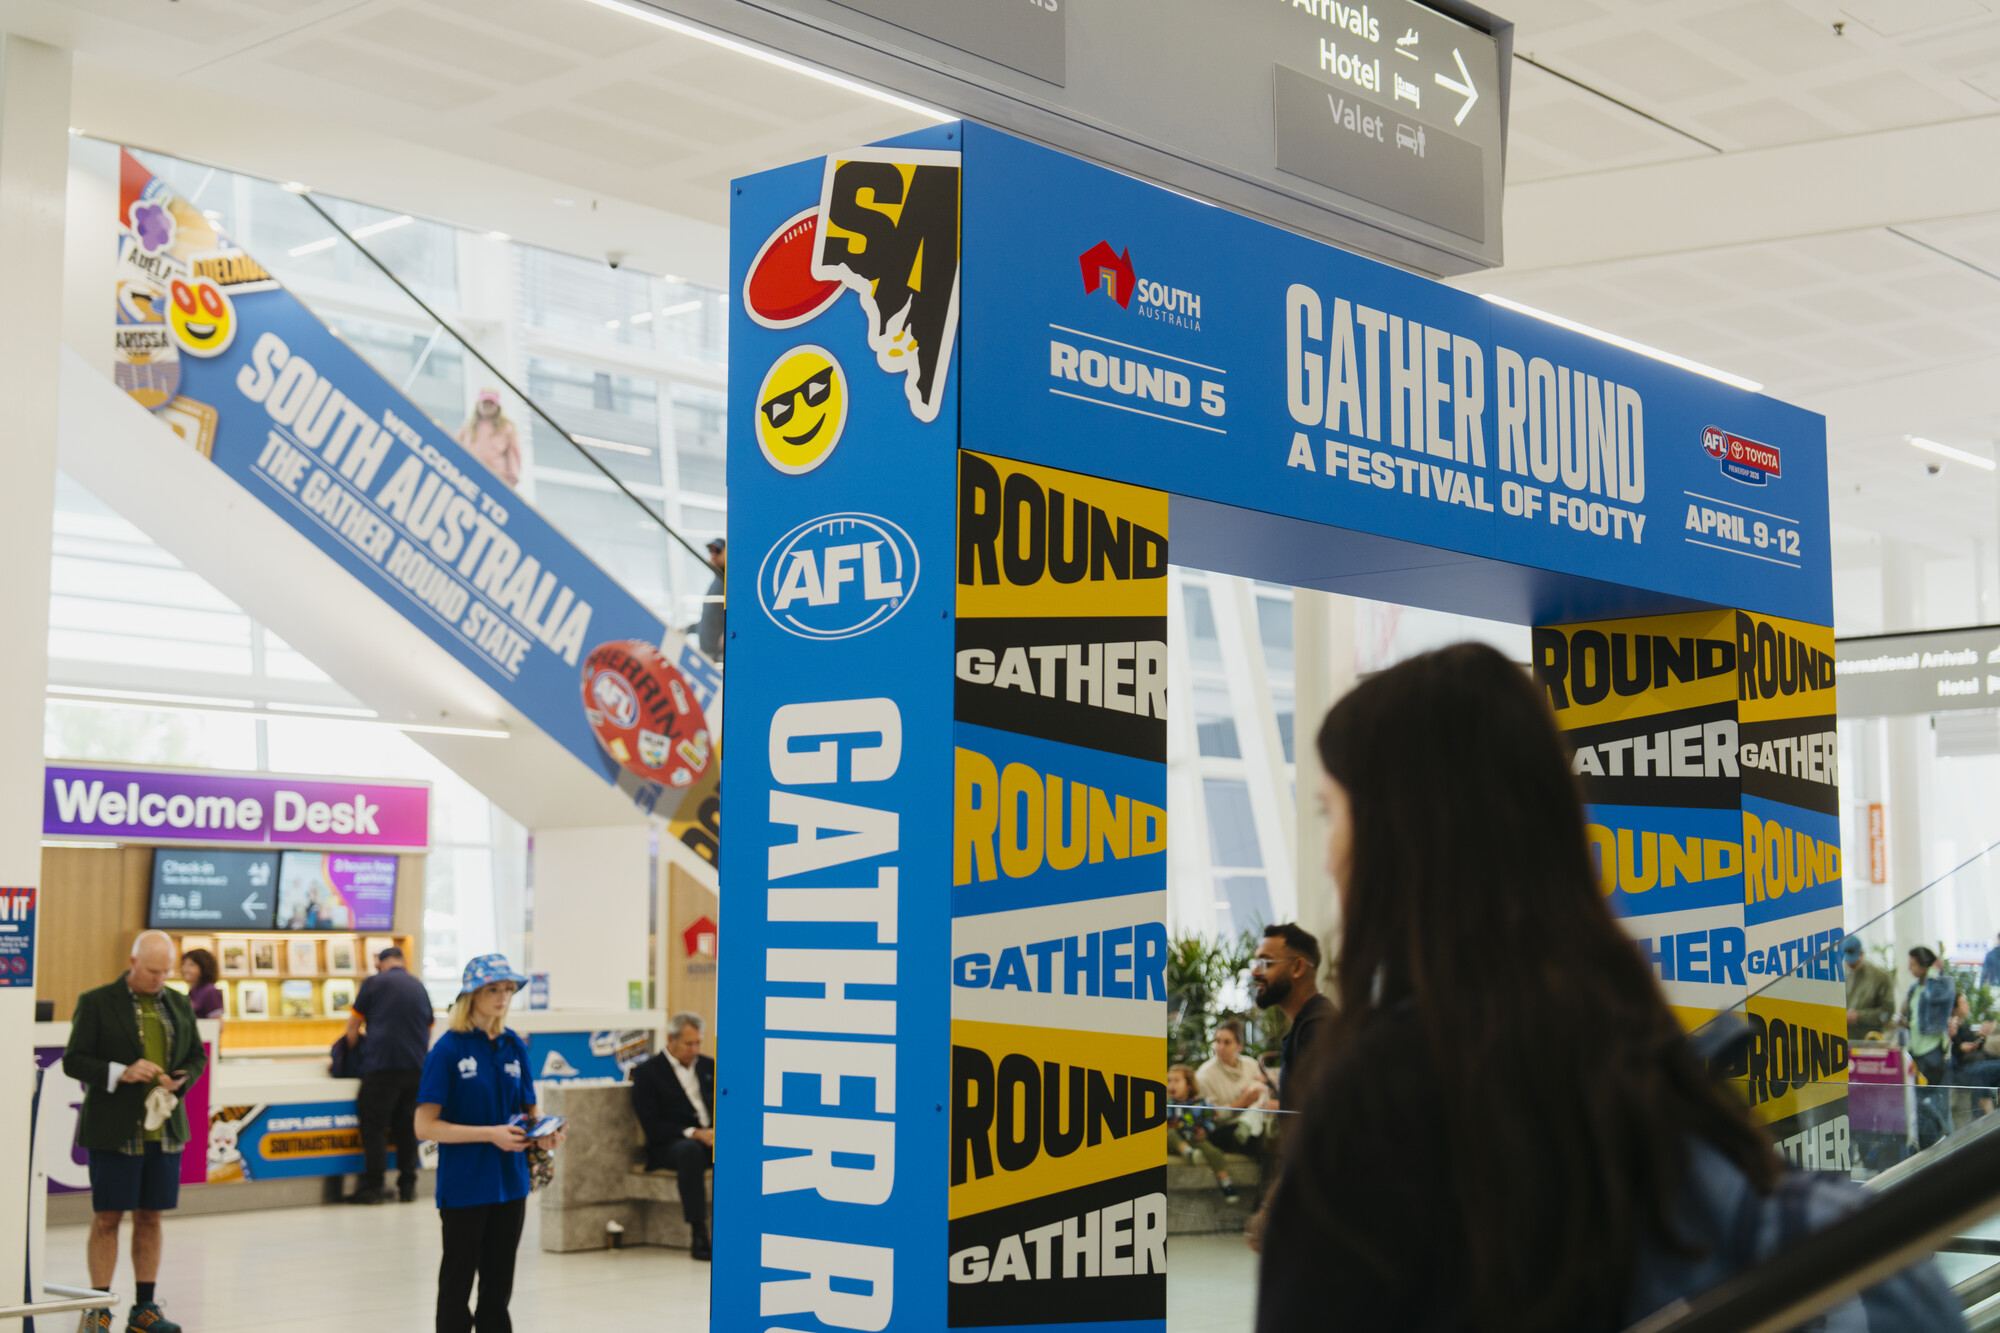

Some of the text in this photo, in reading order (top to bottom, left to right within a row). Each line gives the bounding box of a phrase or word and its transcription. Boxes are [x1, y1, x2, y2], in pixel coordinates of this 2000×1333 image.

[1320, 37, 1380, 93] Hotel
[1327, 93, 1384, 143] Valet
[1137, 278, 1201, 319] SOUTH
[1138, 304, 1201, 332] AUSTRALIA
[1050, 340, 1226, 417] ROUND 5
[1286, 283, 1646, 504] GATHER ROUND
[382, 408, 510, 526] WELCOME TO
[1703, 431, 1728, 453] AFL
[1745, 446, 1779, 469] TOYOTA
[236, 331, 593, 668] SOUTH AUSTRALIA
[958, 450, 1168, 586] ROUND
[1287, 431, 1647, 545] A FESTIVAL OF FOOTY
[256, 429, 312, 495] THE
[301, 468, 396, 564] GATHER
[384, 538, 471, 624] ROUND
[460, 600, 533, 676] STATE
[1685, 504, 1801, 557] APRIL 9-12
[772, 539, 904, 611] AFL
[955, 640, 1168, 721] GATHER
[1533, 627, 1737, 712] ROUND
[1736, 609, 1836, 701] ROUND
[1920, 648, 1979, 669] Arrivals
[1936, 677, 1980, 697] Hotel
[1570, 719, 1740, 778] ATHER
[1740, 731, 1839, 787] GATHER
[53, 778, 380, 835] Welcome Desk
[953, 746, 1168, 887] ROUND
[1584, 823, 1743, 899] OUND
[1742, 810, 1842, 906] ROUND
[762, 697, 903, 1206] GATHER
[953, 921, 1168, 1002] GATHER
[1634, 926, 1747, 986] HER
[1747, 927, 1846, 983] GATHER
[1748, 1012, 1848, 1108] ROUND
[267, 1115, 333, 1131] EXPLORE
[950, 1044, 1168, 1188] ROUND
[949, 1192, 1168, 1285] GATHER
